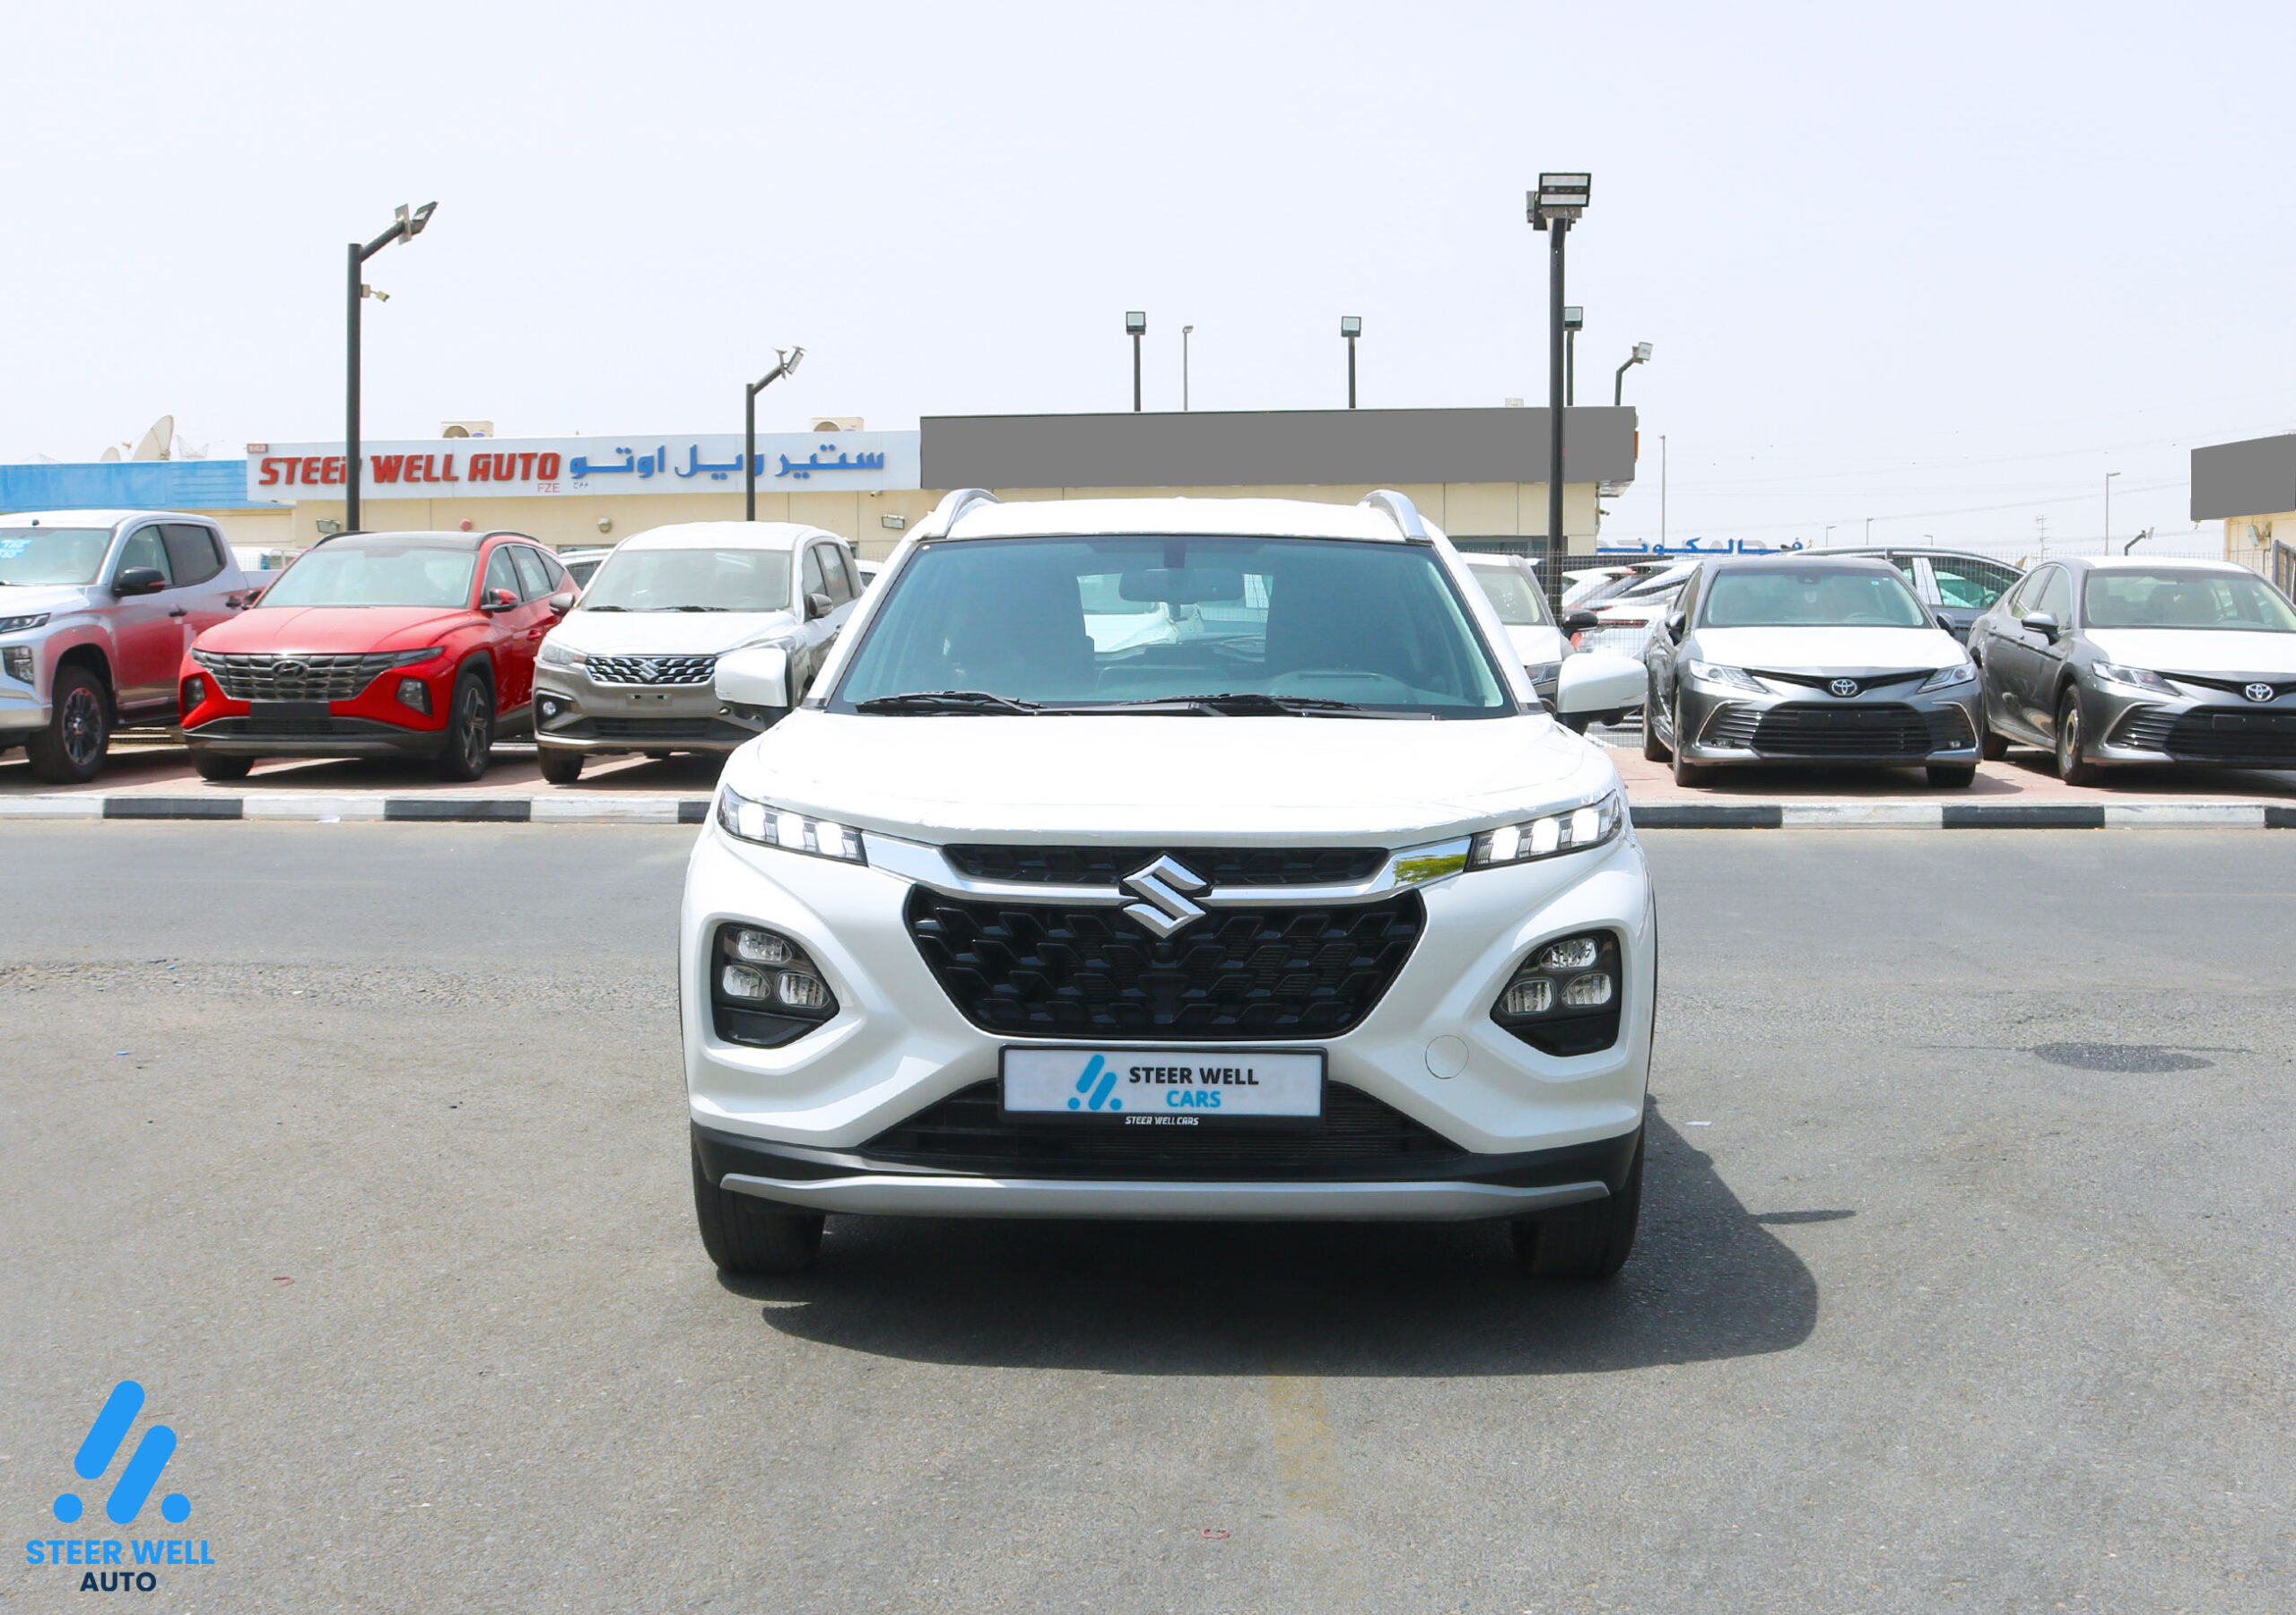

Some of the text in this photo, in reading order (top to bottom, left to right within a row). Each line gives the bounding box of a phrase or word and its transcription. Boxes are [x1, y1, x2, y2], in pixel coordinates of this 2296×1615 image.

[370, 454, 459, 483] WELL
[467, 452, 561, 482] AUTO
[570, 445, 665, 480] اوتو
[774, 444, 884, 478] ستير
[537, 482, 561, 493] FZE
[1128, 1066, 1259, 1085] STEER WELL
[1166, 1090, 1222, 1107] CARS
[1125, 1116, 1199, 1126] STEER WELL CARS
